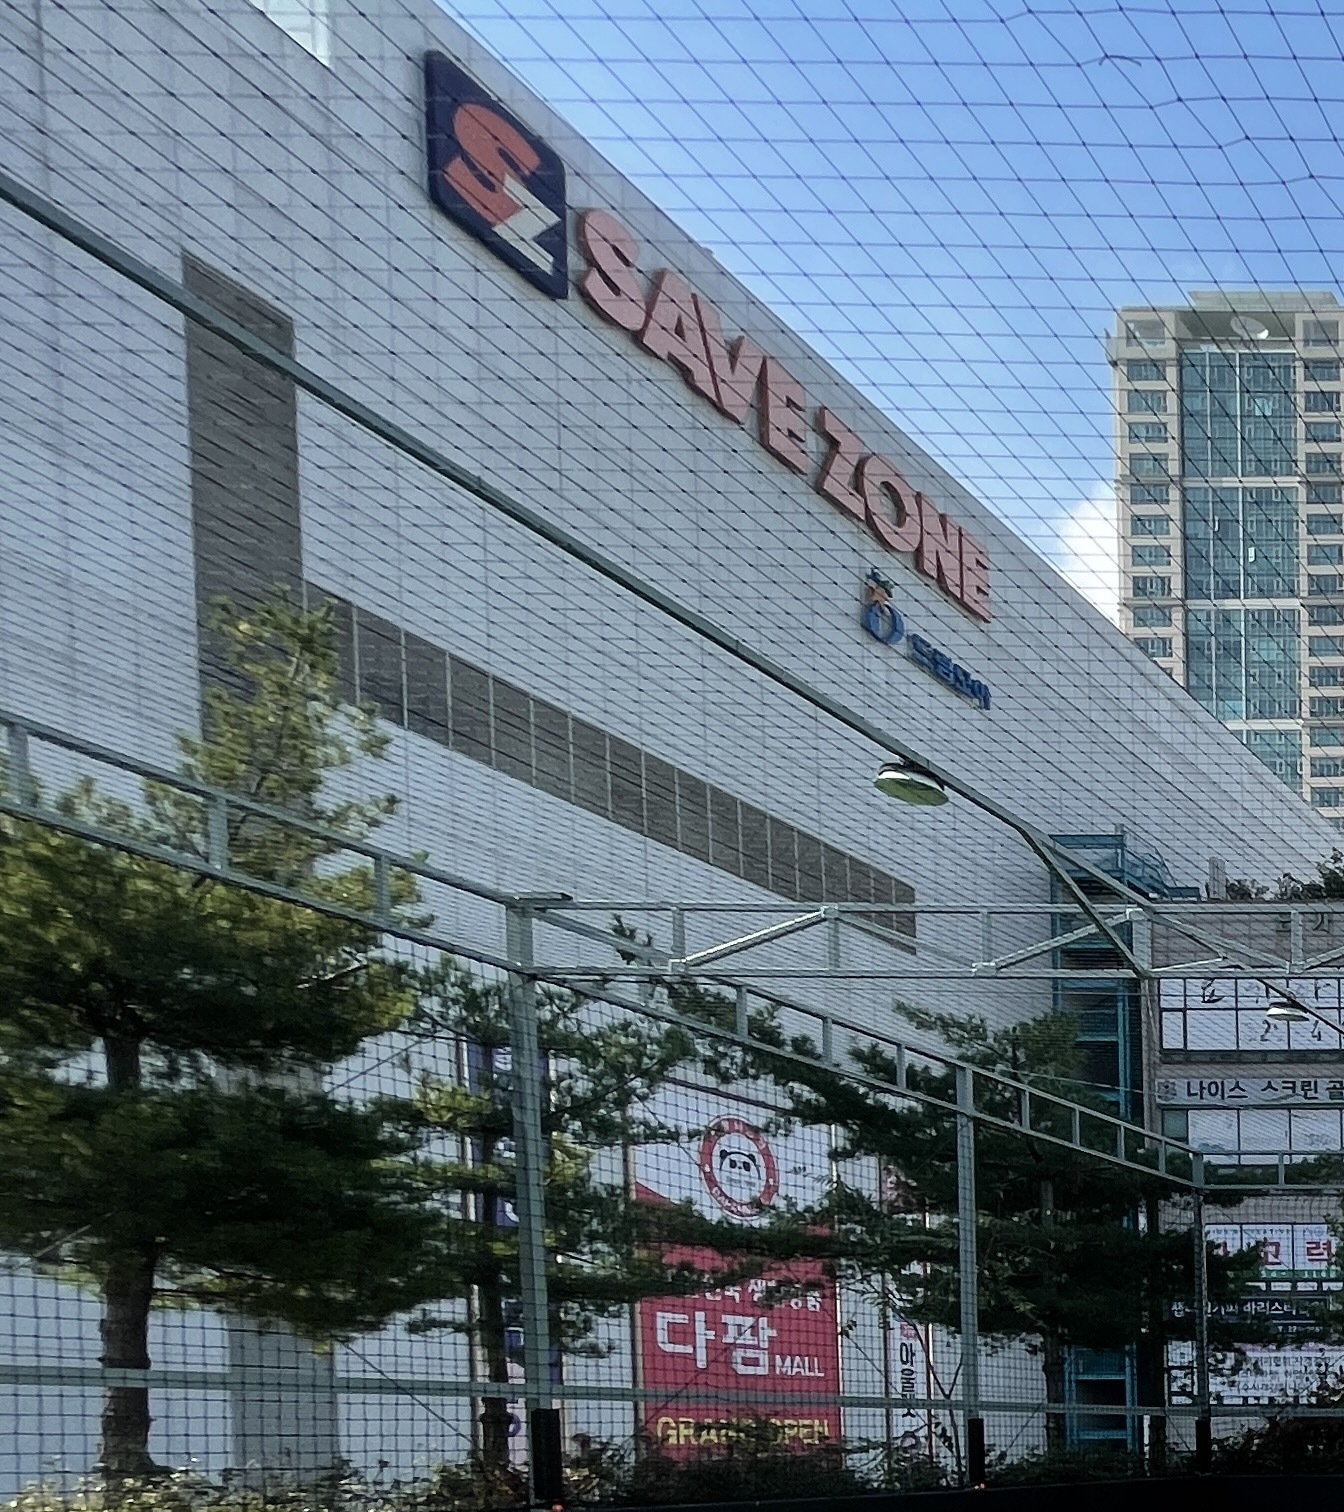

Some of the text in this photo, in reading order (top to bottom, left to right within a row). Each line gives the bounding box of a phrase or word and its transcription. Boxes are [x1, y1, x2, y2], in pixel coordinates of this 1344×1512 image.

[1186, 1080, 1248, 1100] 나이스
[1261, 1080, 1318, 1100] 스크린
[656, 1311, 825, 1377] 다팜 MALL
